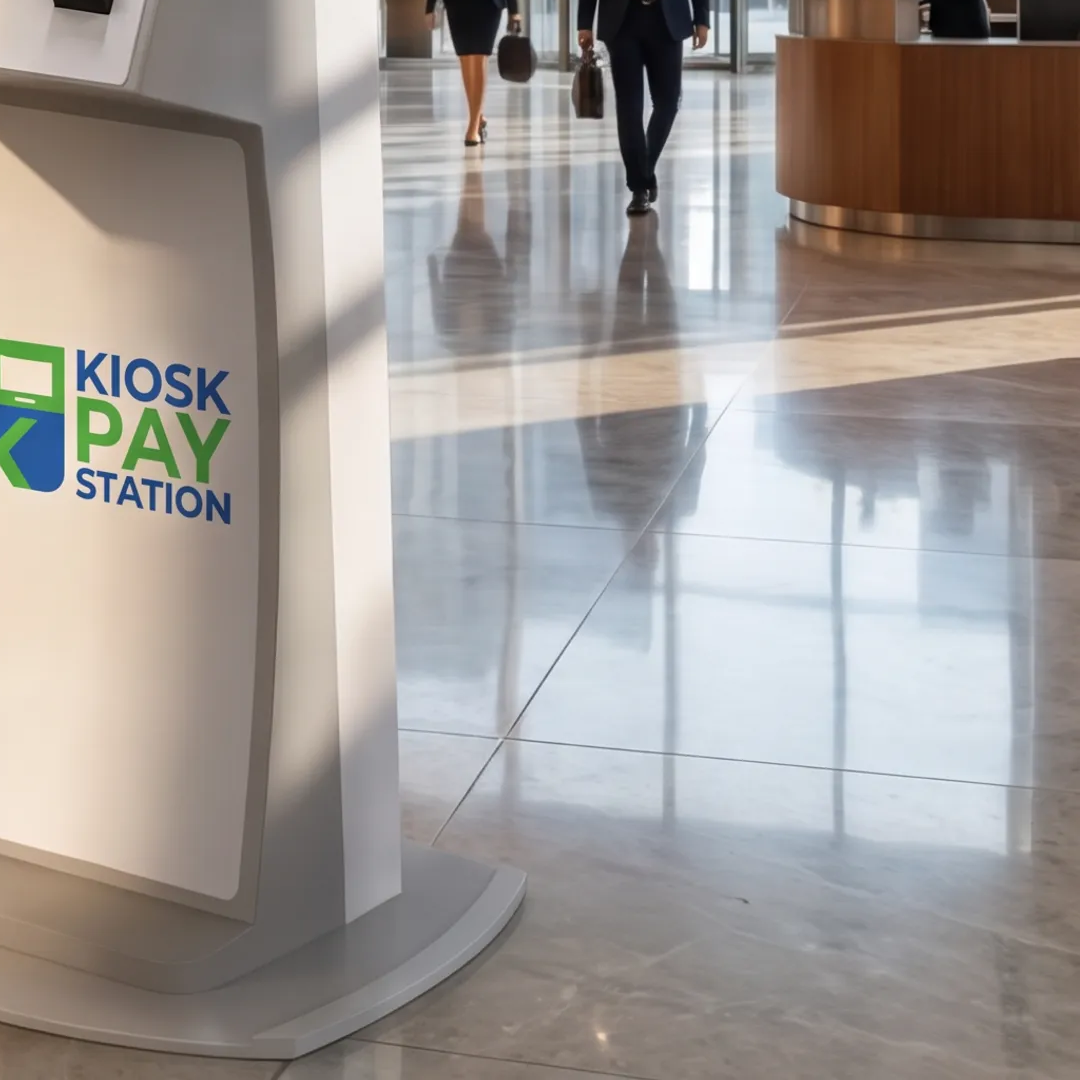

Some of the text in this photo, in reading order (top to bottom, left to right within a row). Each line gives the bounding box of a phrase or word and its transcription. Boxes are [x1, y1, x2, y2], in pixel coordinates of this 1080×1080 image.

[76, 349, 231, 415] KIOSK
[76, 396, 231, 484] PAY
[76, 468, 231, 525] STATION
